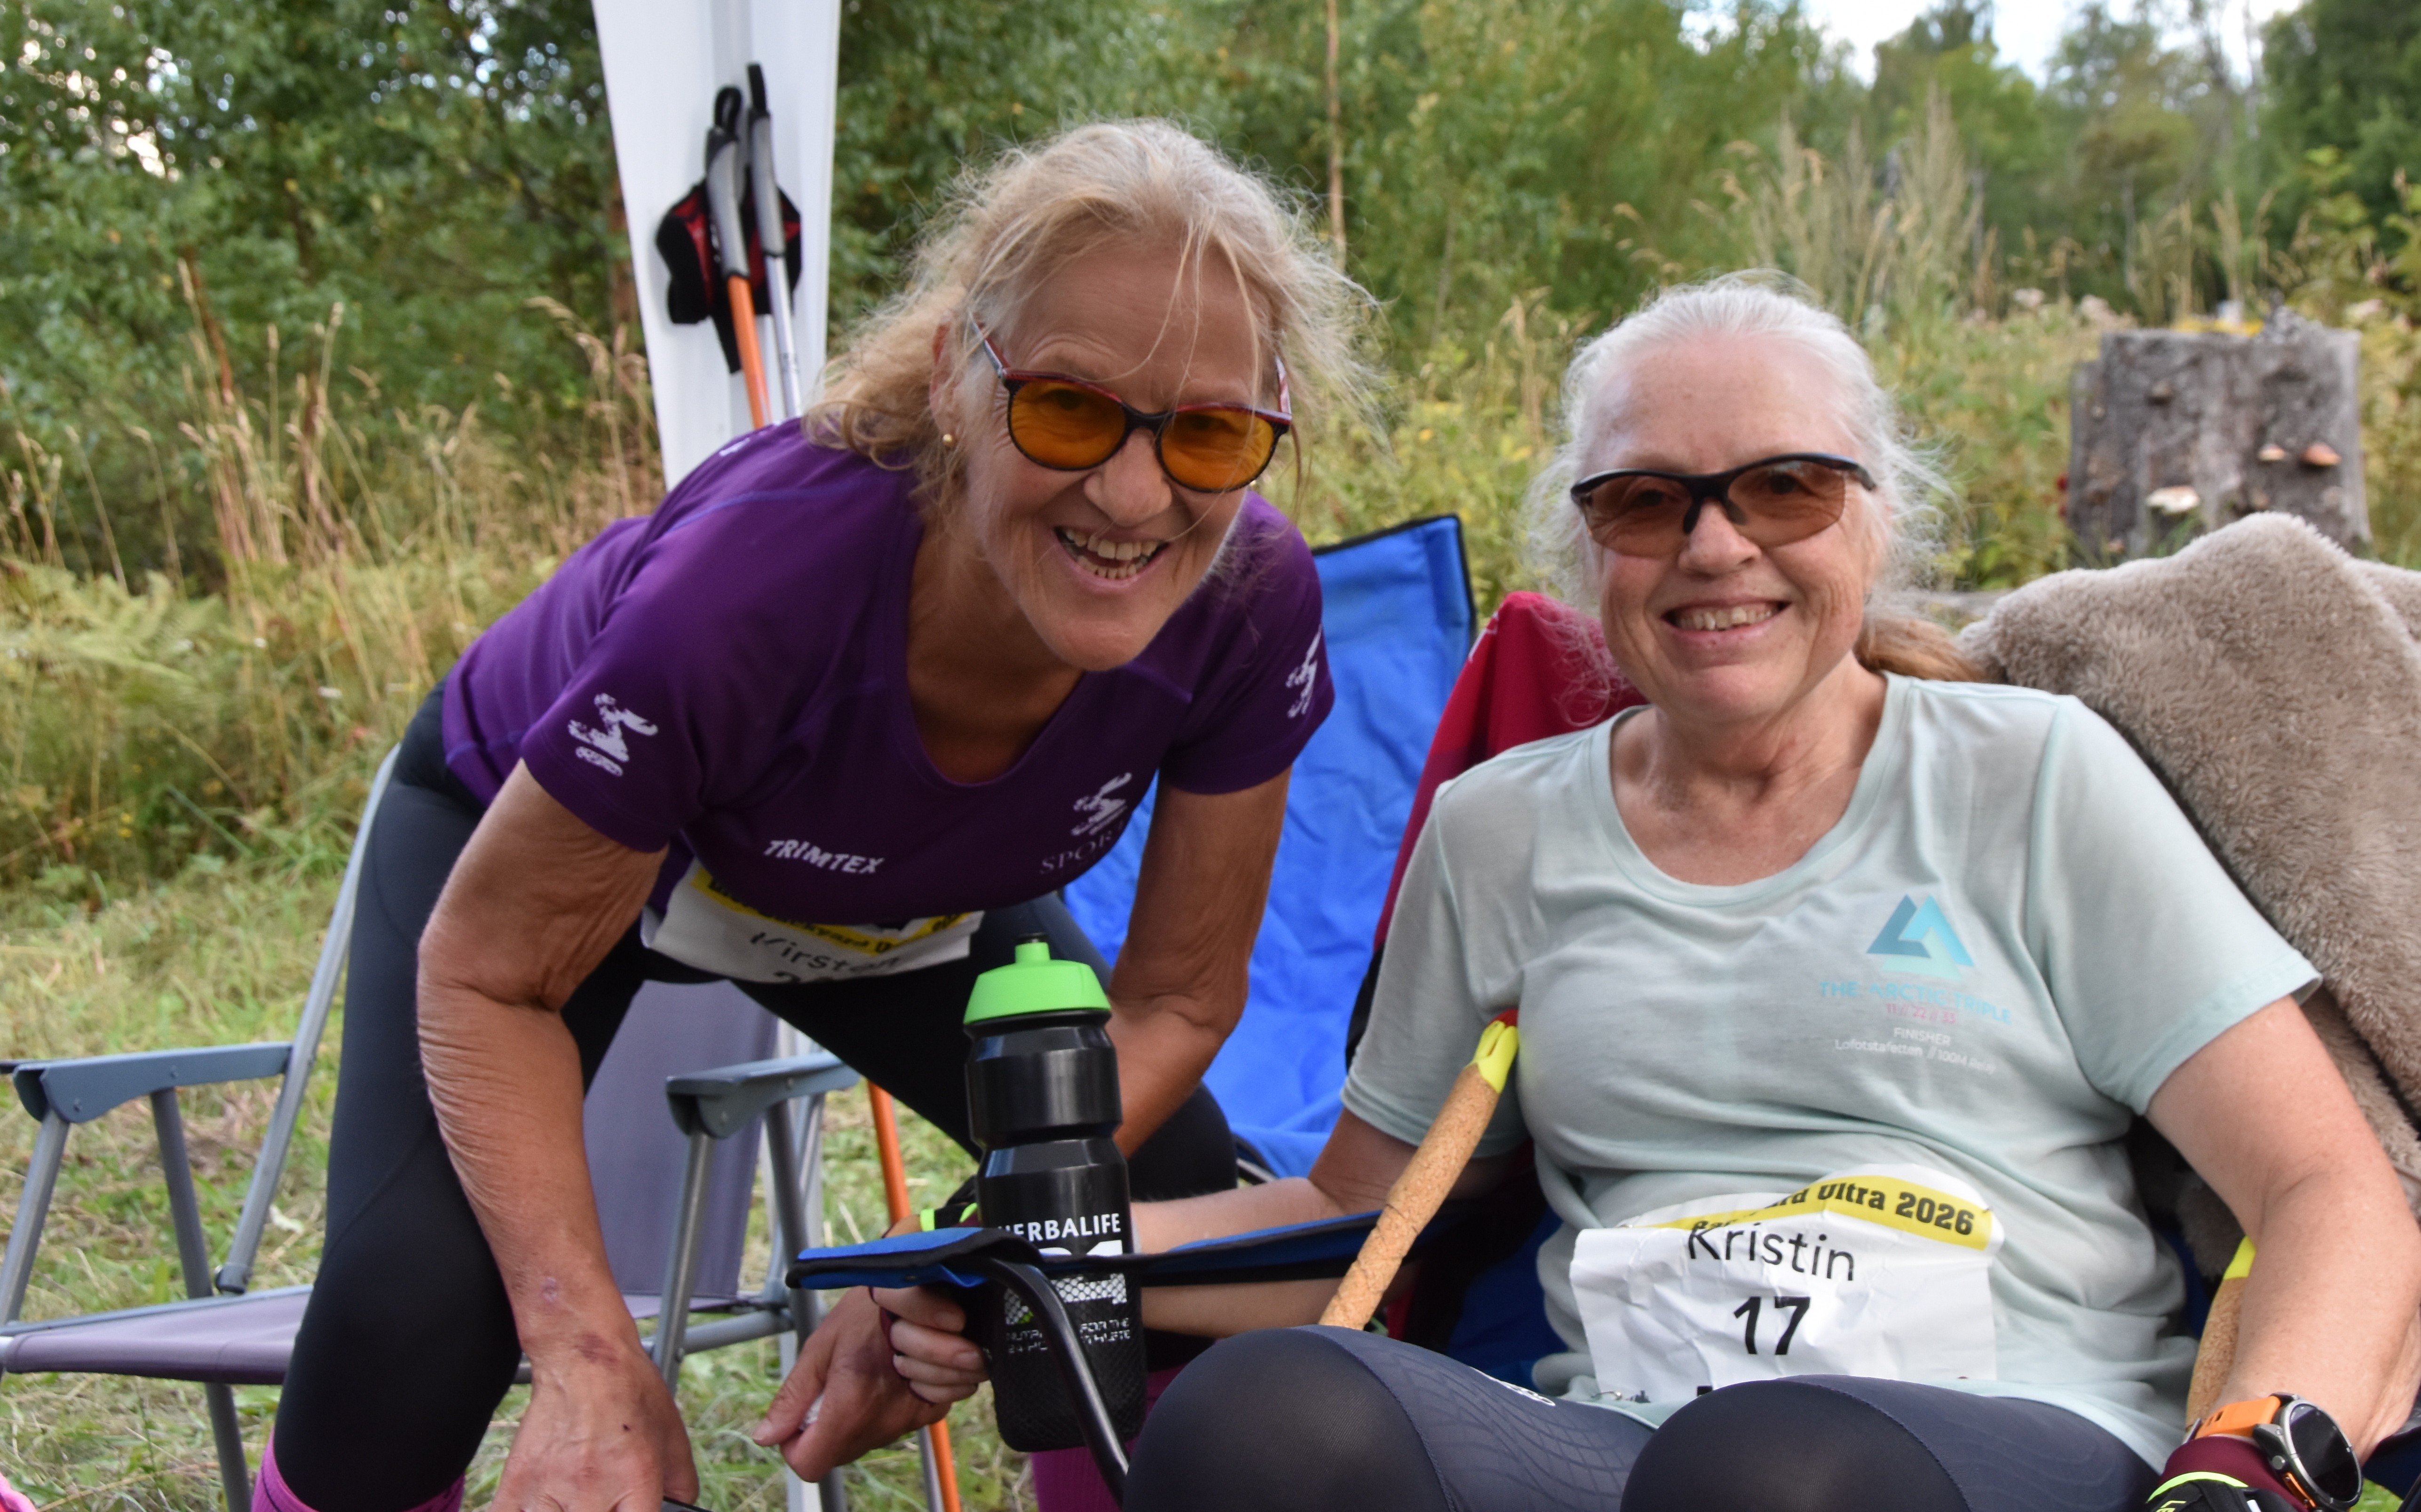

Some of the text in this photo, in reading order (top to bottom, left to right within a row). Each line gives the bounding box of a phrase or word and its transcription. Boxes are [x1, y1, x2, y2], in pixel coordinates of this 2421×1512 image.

[763, 839, 885, 874] TRIMTEX
[1819, 981, 2012, 1025] THE ARCTIC TRIPLE
[1893, 1027, 1951, 1047] FINISHER
[997, 1213, 1122, 1243] ERBALIFE
[1817, 1182, 1886, 1211] Ultra
[1895, 1186, 1975, 1236] 2026
[1688, 1220, 1855, 1282] Kristin
[1733, 1296, 1811, 1355] 17
